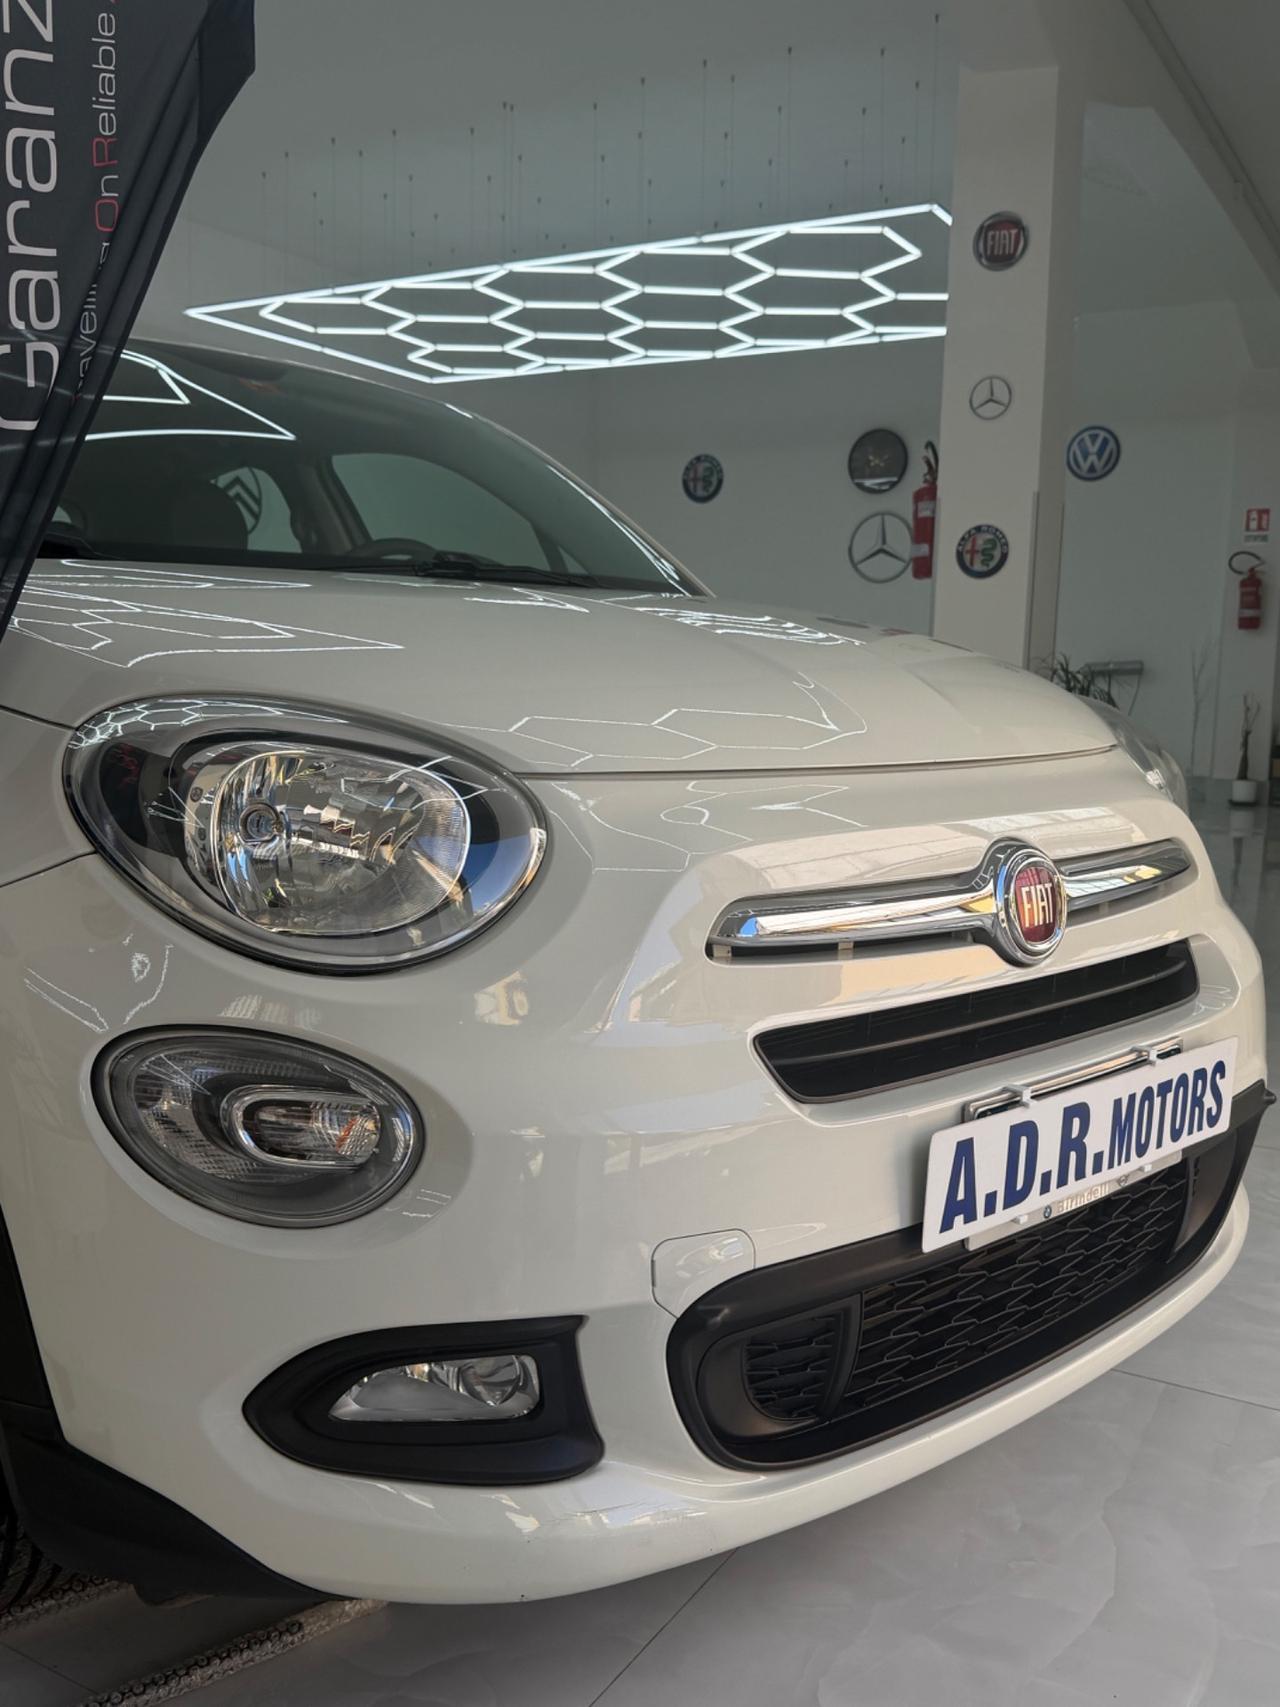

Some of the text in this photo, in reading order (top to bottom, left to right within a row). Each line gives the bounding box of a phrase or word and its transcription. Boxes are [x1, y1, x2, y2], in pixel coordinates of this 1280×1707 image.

[91, 12, 118, 168] Reliable
[95, 174, 119, 233] On
[987, 228, 1019, 256] FIAT
[1021, 882, 1053, 929] FIAT
